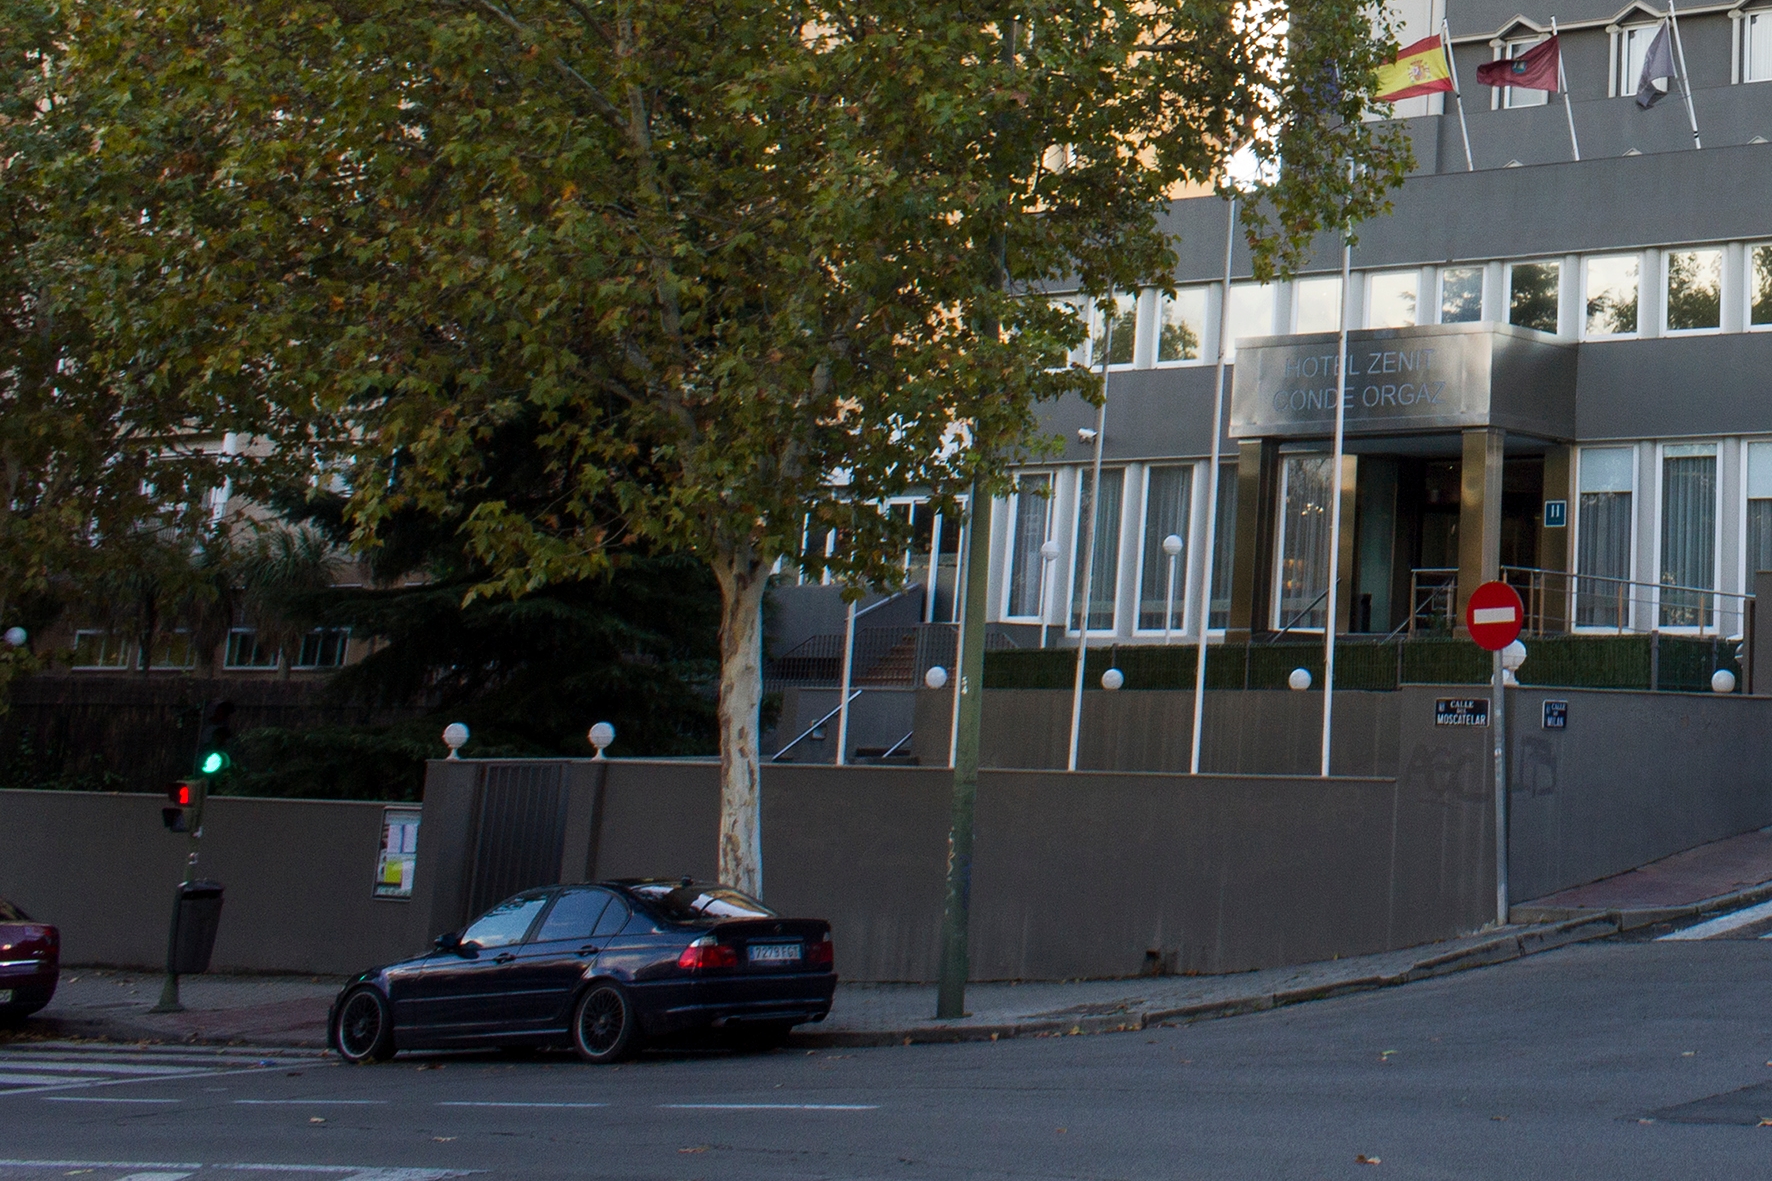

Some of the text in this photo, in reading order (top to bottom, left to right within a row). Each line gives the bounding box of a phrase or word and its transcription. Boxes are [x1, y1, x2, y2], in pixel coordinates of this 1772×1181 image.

[1367, 349, 1435, 374] ZENIT
[1362, 381, 1446, 407] ORGAZ
[1450, 700, 1475, 709] CALLE
[1437, 713, 1486, 725] MOSCATELAR
